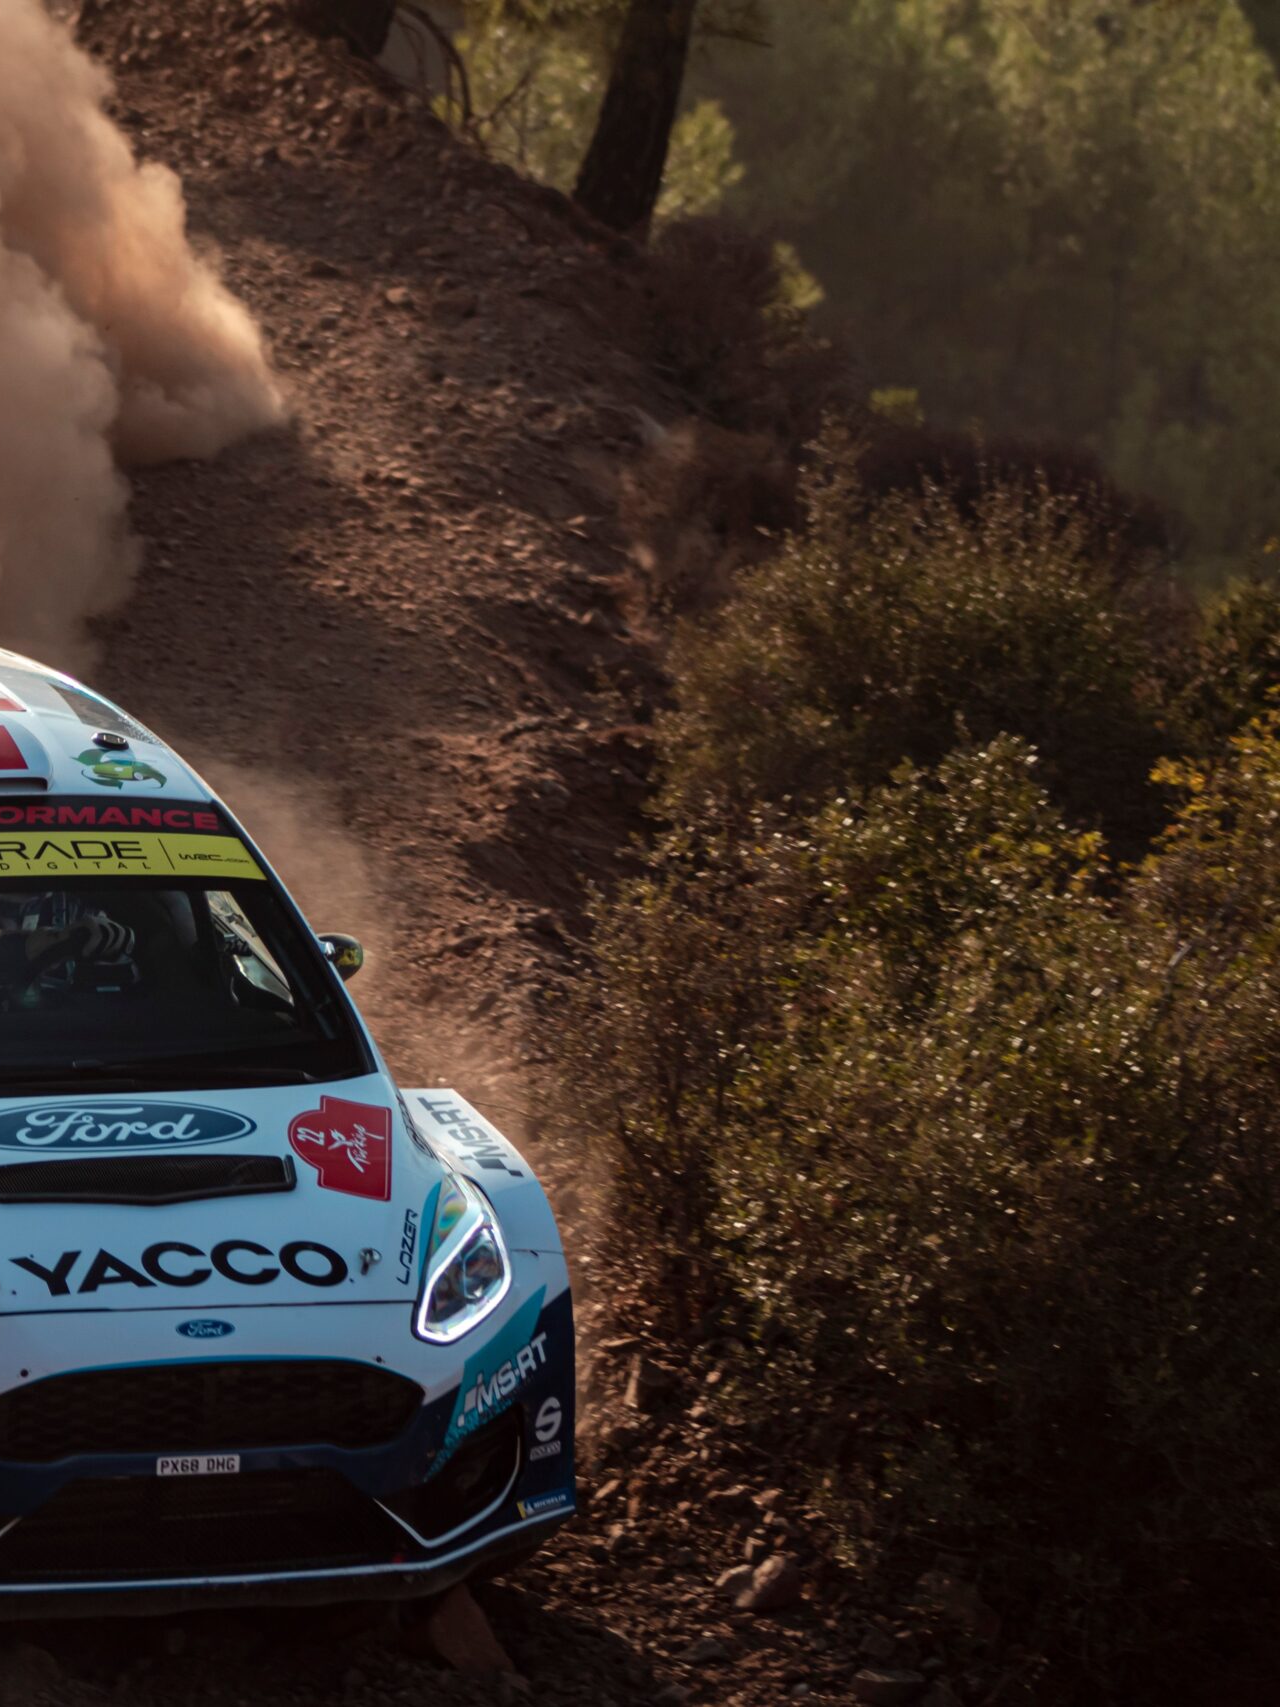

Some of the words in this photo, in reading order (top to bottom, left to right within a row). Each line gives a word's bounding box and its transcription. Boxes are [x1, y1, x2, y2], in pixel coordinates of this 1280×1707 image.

[0, 860, 151, 872] DIGITAL
[15, 1106, 201, 1146] Ford
[296, 1126, 326, 1146] 22
[8, 1239, 349, 1297] YACCO
[160, 1458, 200, 1473] PX68
[206, 1457, 236, 1472] DHG
